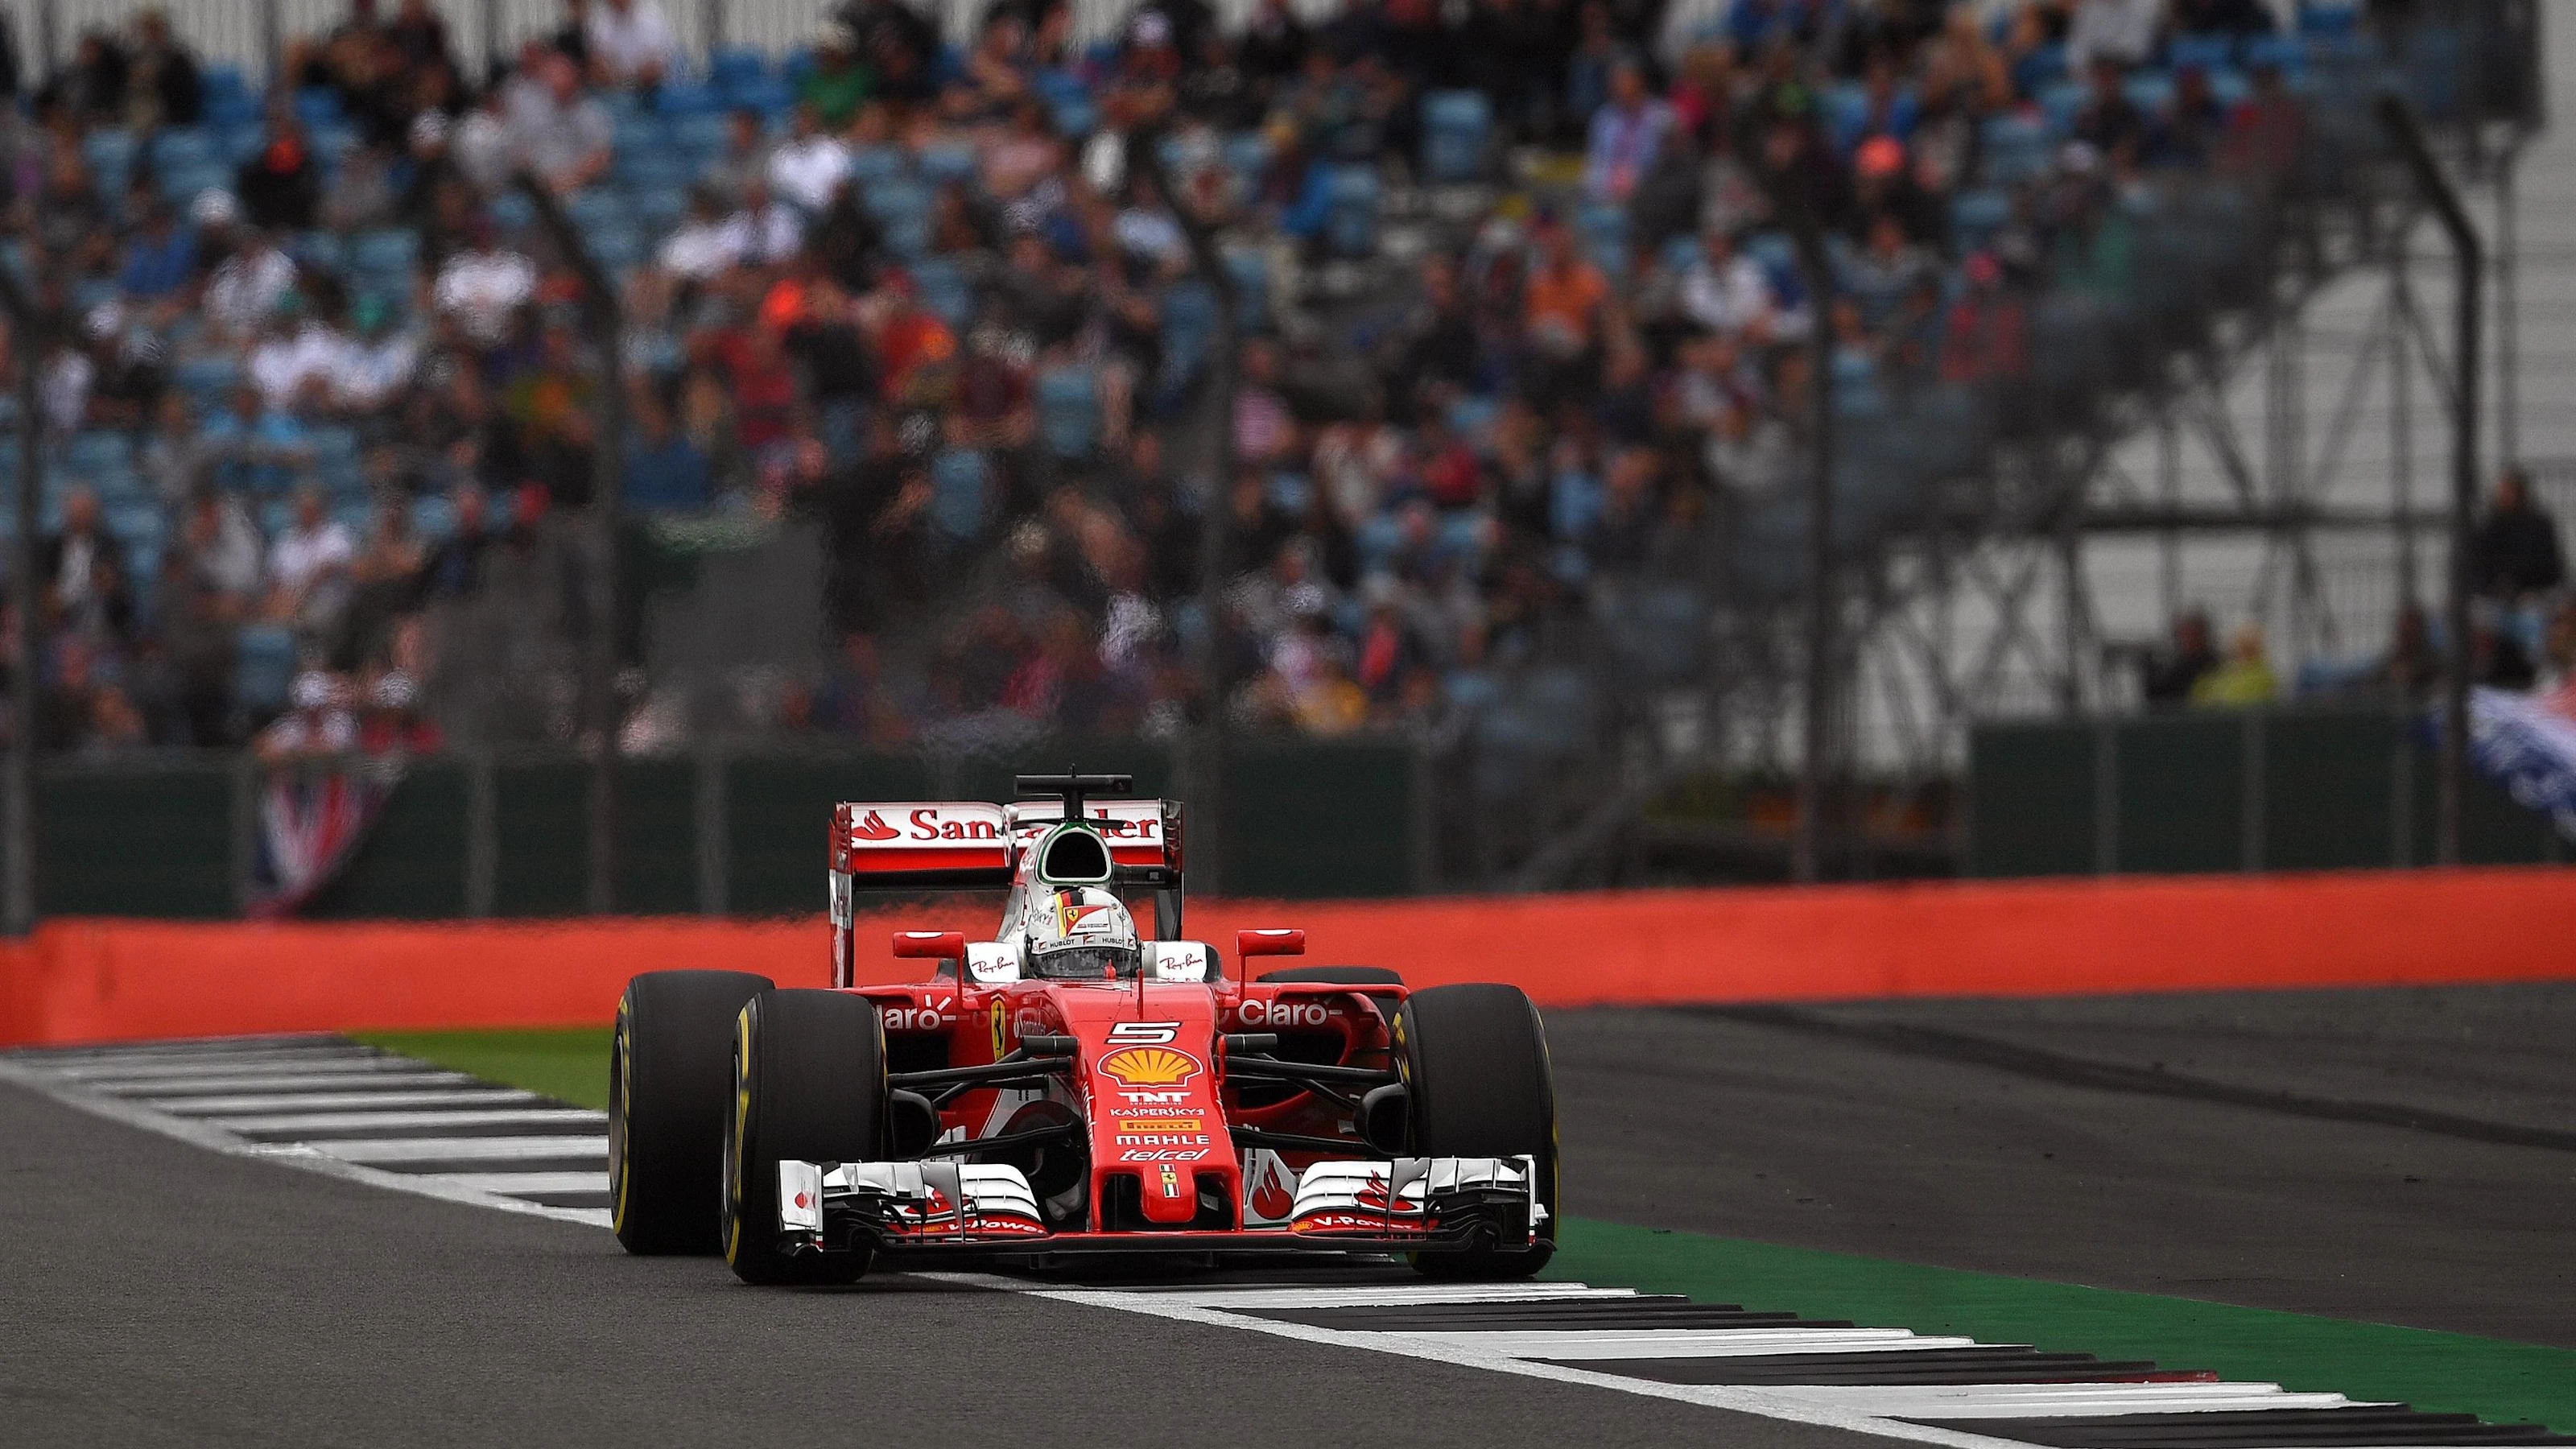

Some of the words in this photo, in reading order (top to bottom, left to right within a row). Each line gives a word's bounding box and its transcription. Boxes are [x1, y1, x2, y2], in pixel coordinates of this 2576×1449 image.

[910, 809, 1158, 840] Saner
[1050, 939, 1075, 948] HUBLOT
[972, 956, 1014, 973] Ray-Ban
[1159, 953, 1203, 970] Ray-Ban
[876, 1004, 940, 1030] laro
[1238, 999, 1327, 1026] Claro
[1104, 1022, 1183, 1044] 5
[1117, 1092, 1192, 1104] TNT
[1116, 1135, 1210, 1146] MAHLE
[1119, 1148, 1210, 1162] telcel
